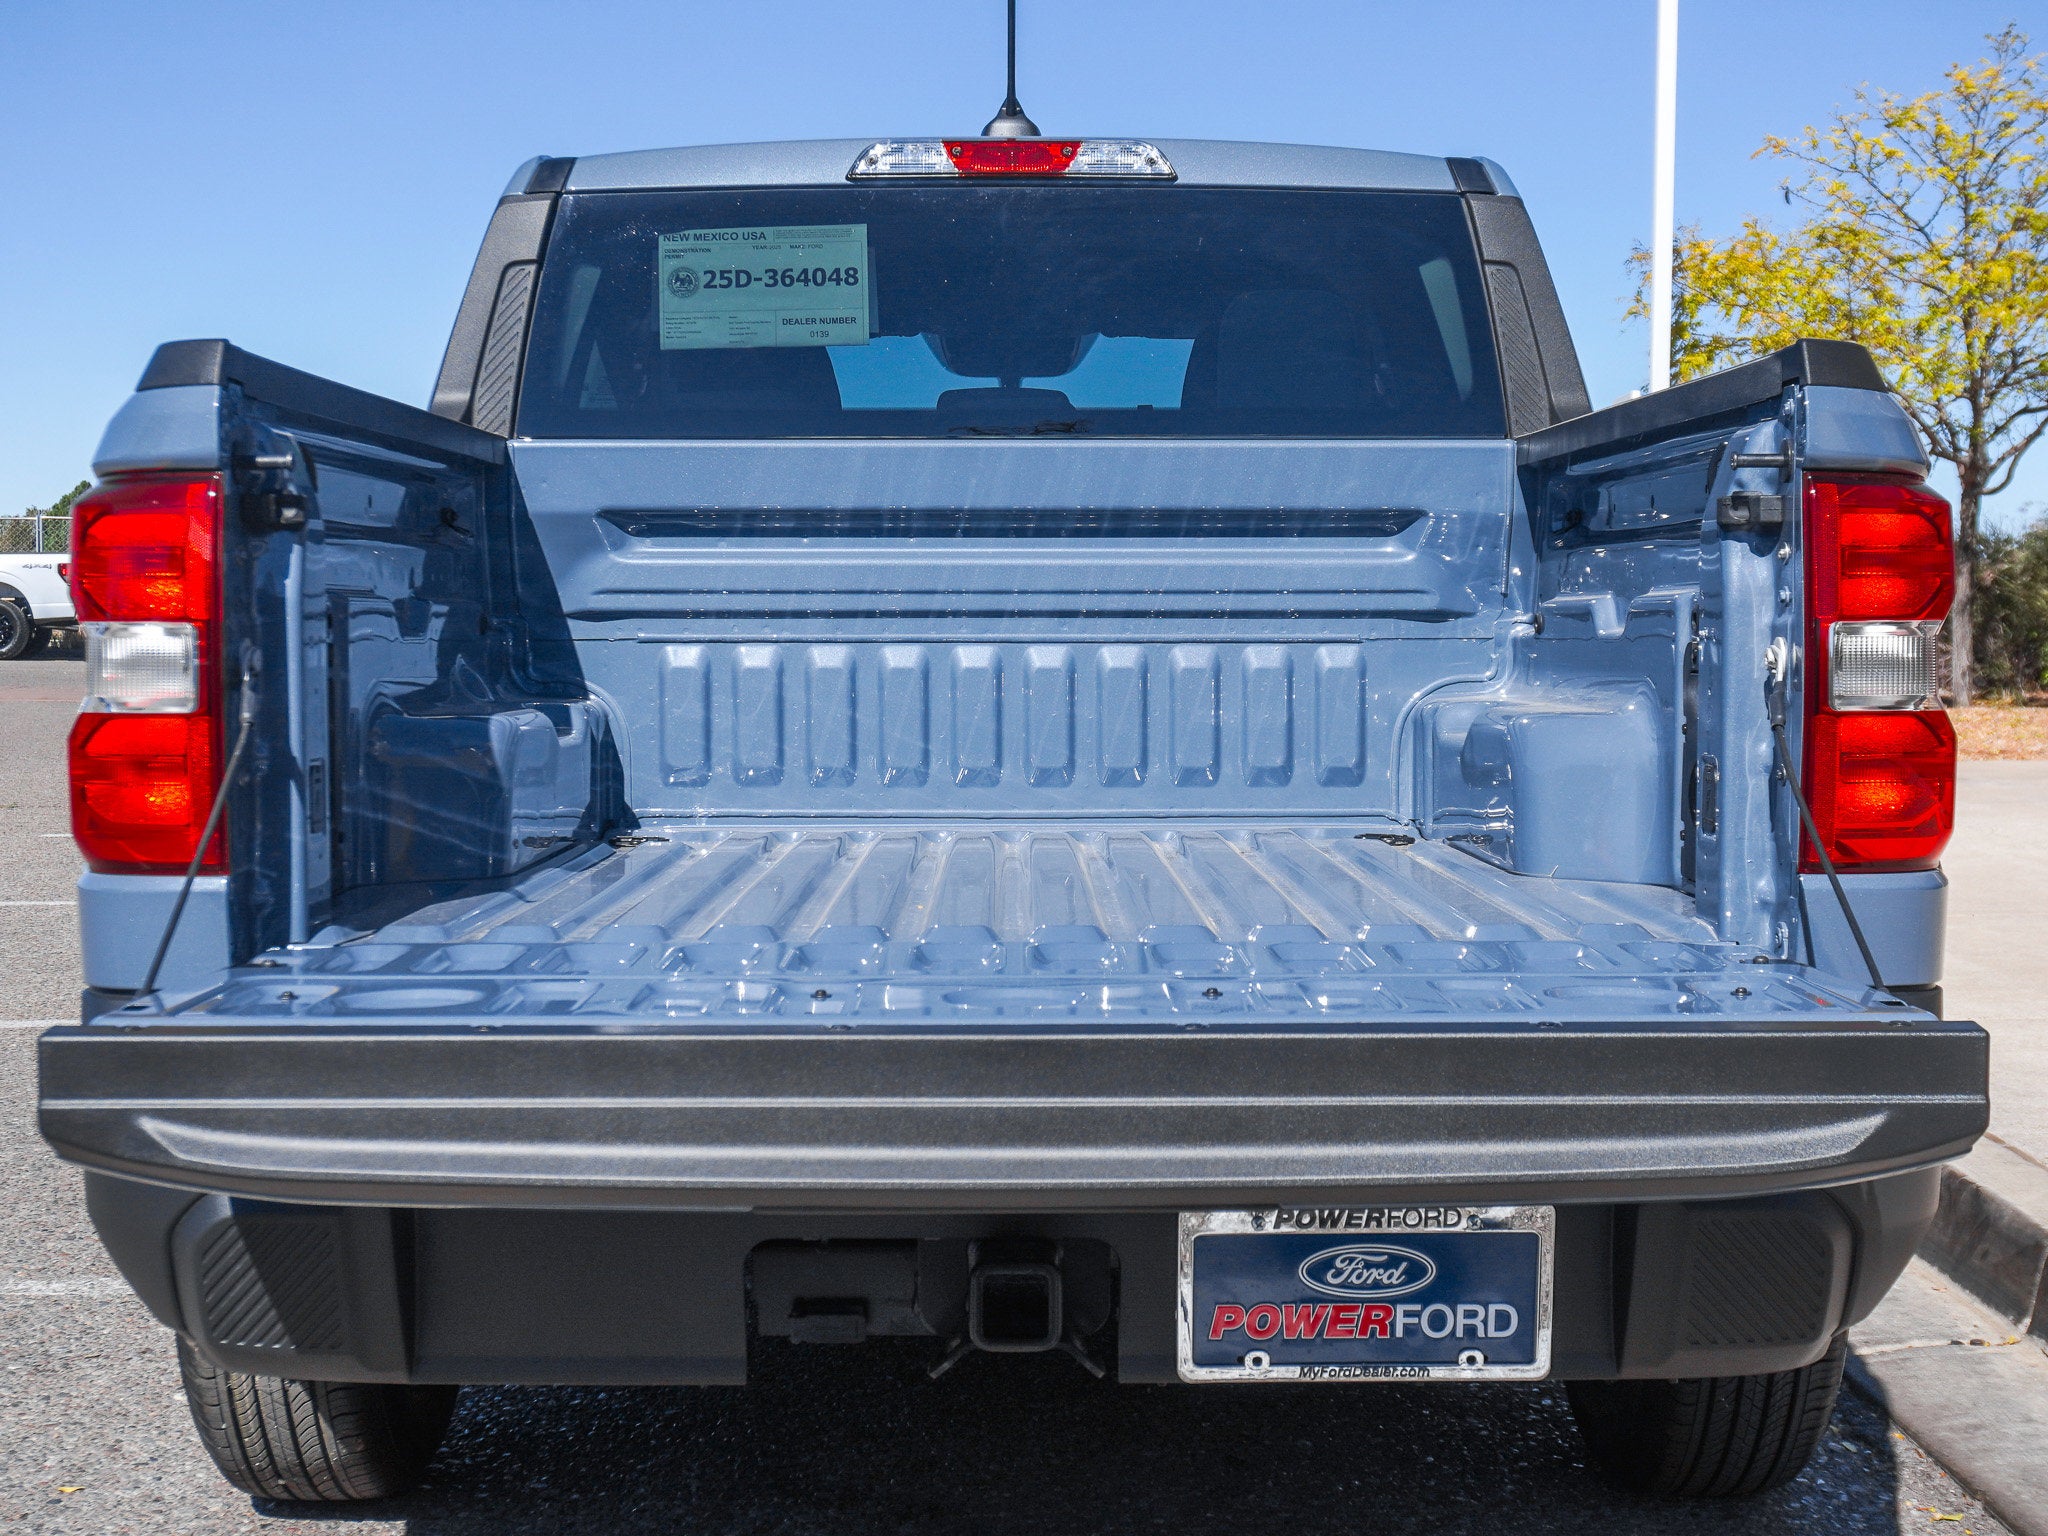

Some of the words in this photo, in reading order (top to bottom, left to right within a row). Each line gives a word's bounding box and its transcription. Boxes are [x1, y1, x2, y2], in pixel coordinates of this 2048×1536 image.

[663, 233, 690, 242] NEW
[694, 231, 739, 241] MEXICO
[743, 231, 767, 241] USA
[703, 267, 860, 289] 25D-364048
[782, 318, 817, 326] DEALER
[820, 316, 857, 325] NUMBER
[809, 330, 829, 338] 0139
[1273, 1208, 1462, 1230] POWERFORD
[1326, 1253, 1408, 1285] Ford
[1208, 1303, 1519, 1341] POWERFORD
[1299, 1365, 1430, 1381] MyFordDealer.com
